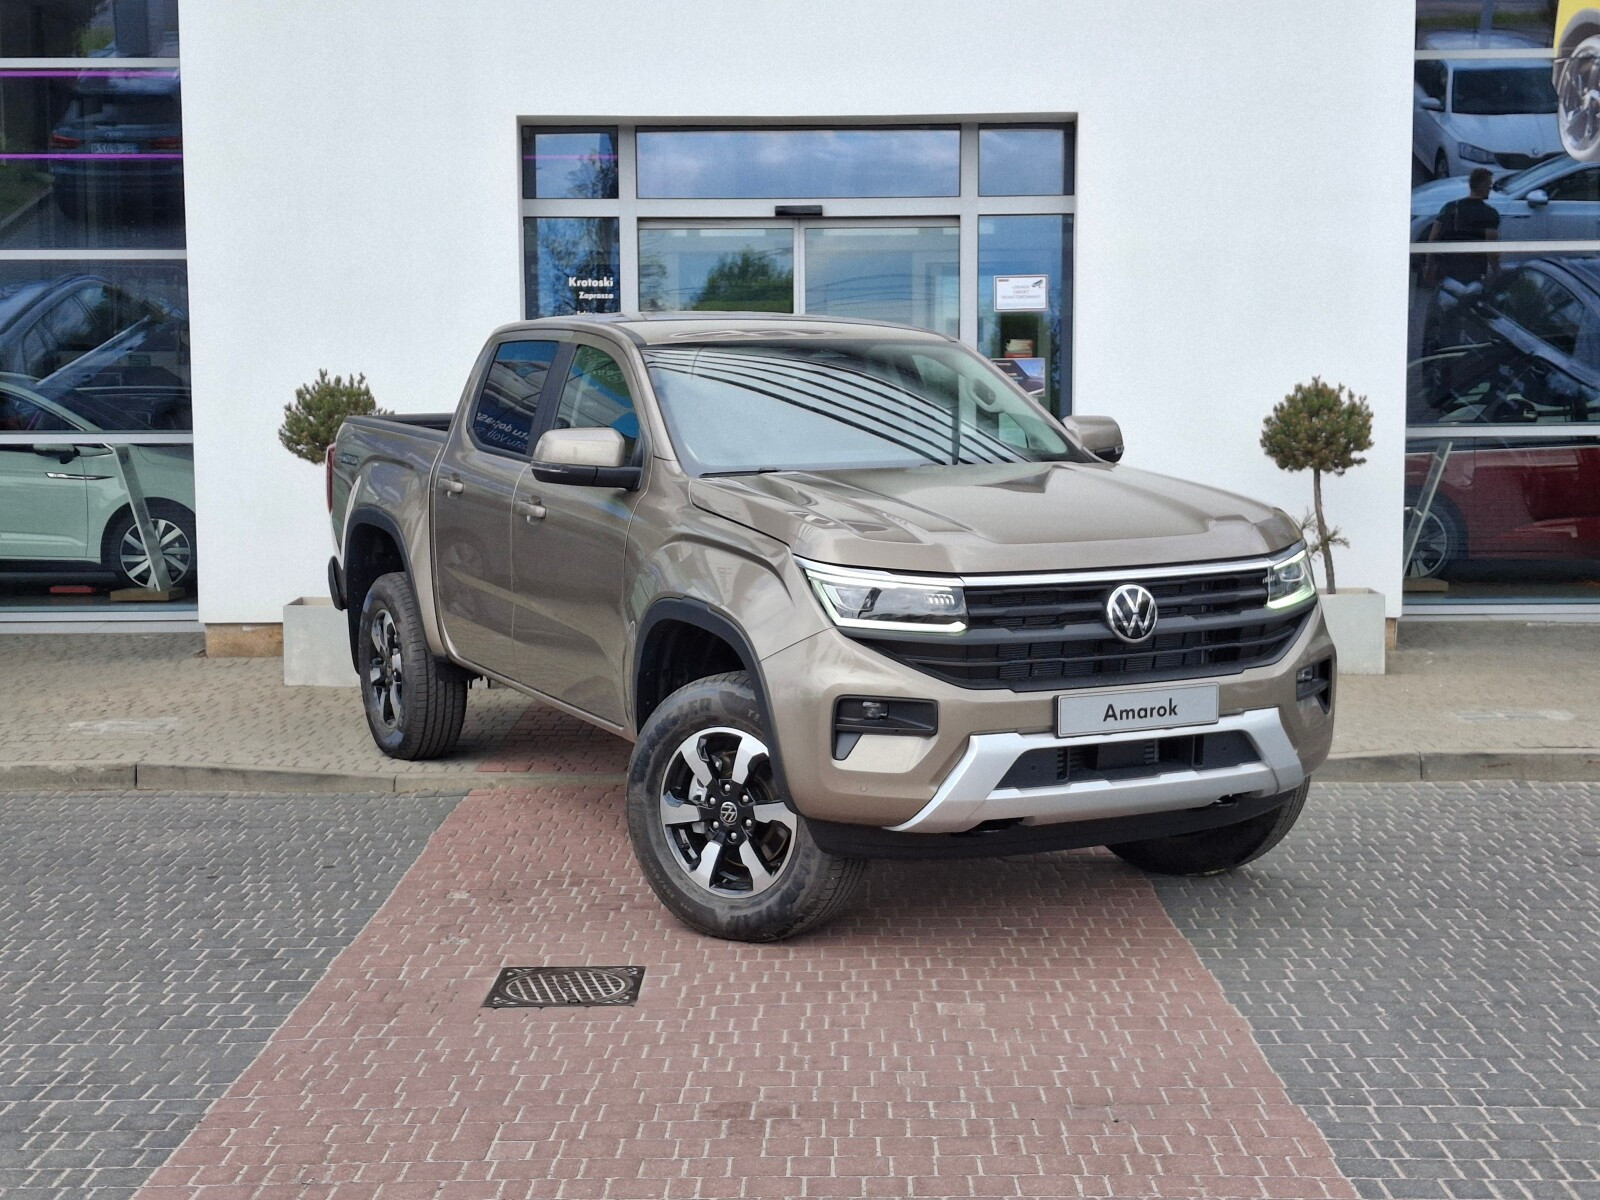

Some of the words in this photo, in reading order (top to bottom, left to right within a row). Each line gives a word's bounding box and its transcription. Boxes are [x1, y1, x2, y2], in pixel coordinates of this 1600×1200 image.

[568, 276, 614, 287] Krotoski
[578, 291, 614, 301] Zaprasza
[1103, 698, 1178, 722] Amarok
